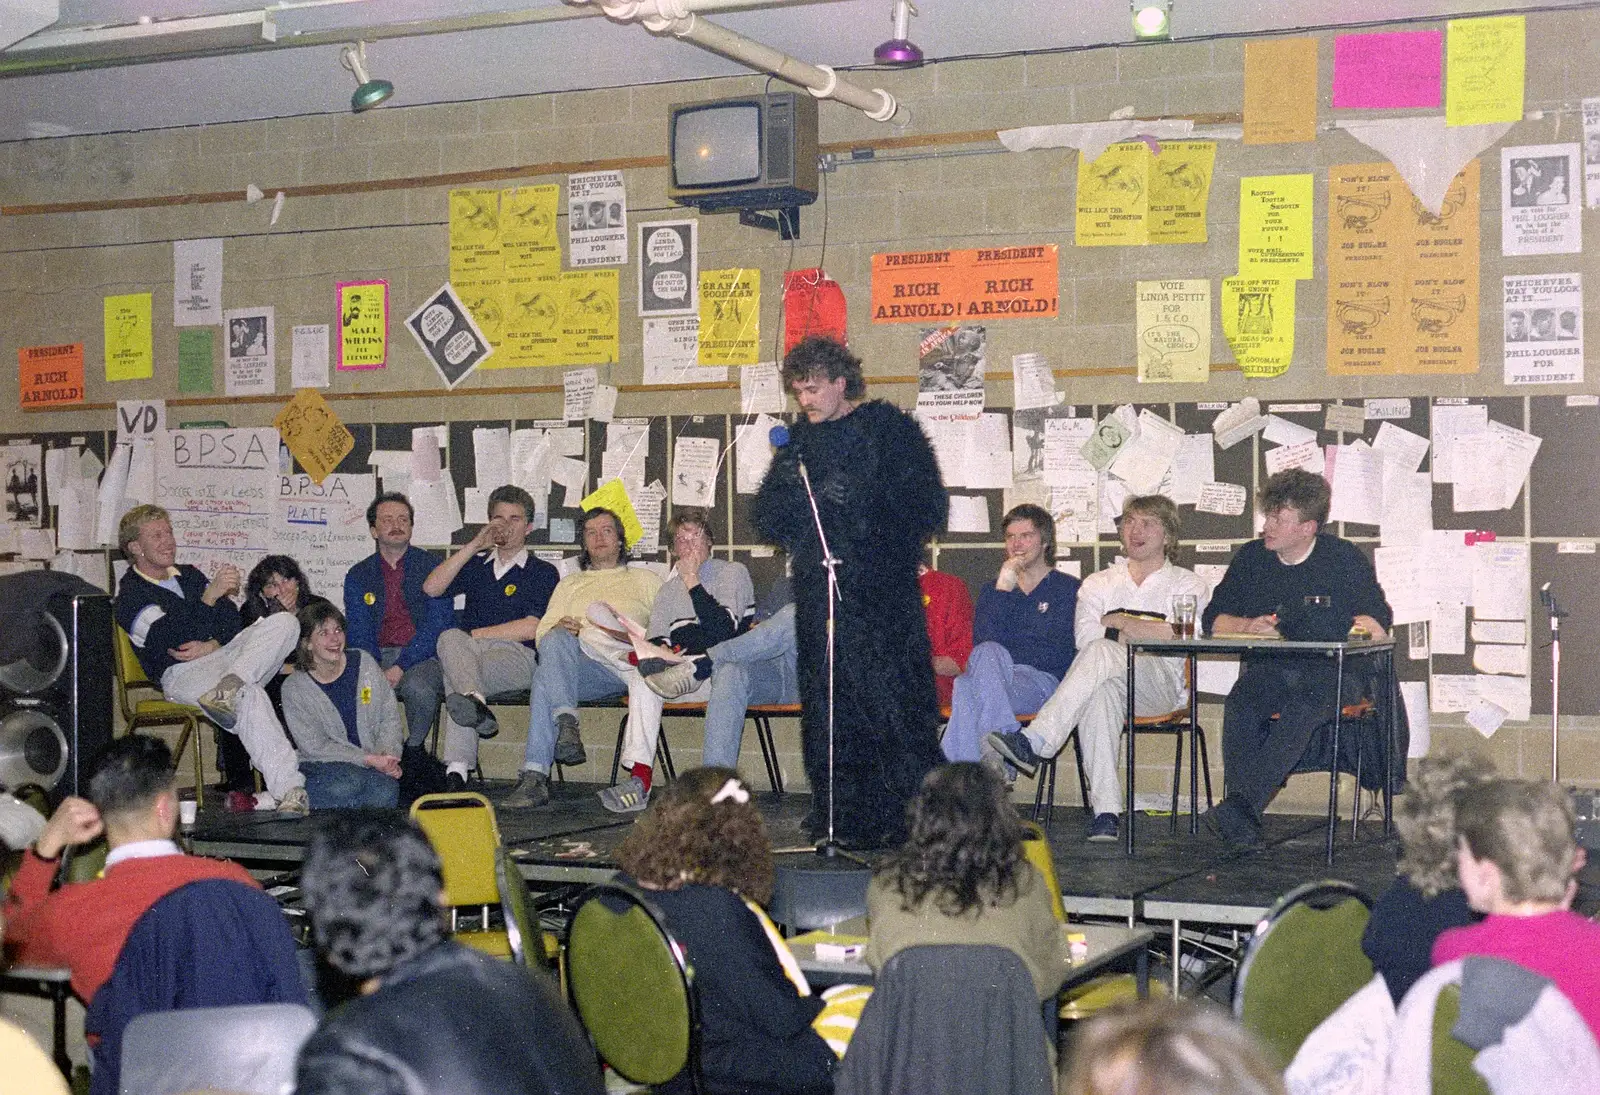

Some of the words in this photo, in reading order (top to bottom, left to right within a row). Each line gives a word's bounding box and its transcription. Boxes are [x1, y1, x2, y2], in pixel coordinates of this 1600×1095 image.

[570, 175, 617, 184] WHICHEVER
[1534, 212, 1569, 221] LOUGHER
[1518, 235, 1564, 243] PRESIDENT
[577, 256, 621, 264] PRESIDENT
[886, 252, 950, 266] PRESIDENT
[977, 248, 1044, 261] PRESIDENT
[985, 279, 1034, 293] RICH
[1506, 278, 1572, 287] WHICHEVER
[894, 282, 939, 297] RICH
[1173, 293, 1205, 301] PETTIT
[700, 340, 755, 348] PRESIDENT
[28, 345, 74, 358] PRESIDENT
[1533, 348, 1580, 356] LOUGHER
[34, 371, 67, 384] RICH
[1514, 374, 1575, 382] PRESIDENT
[1369, 402, 1408, 417] SAILING
[120, 406, 158, 433] VD
[288, 506, 326, 520] PLATE
